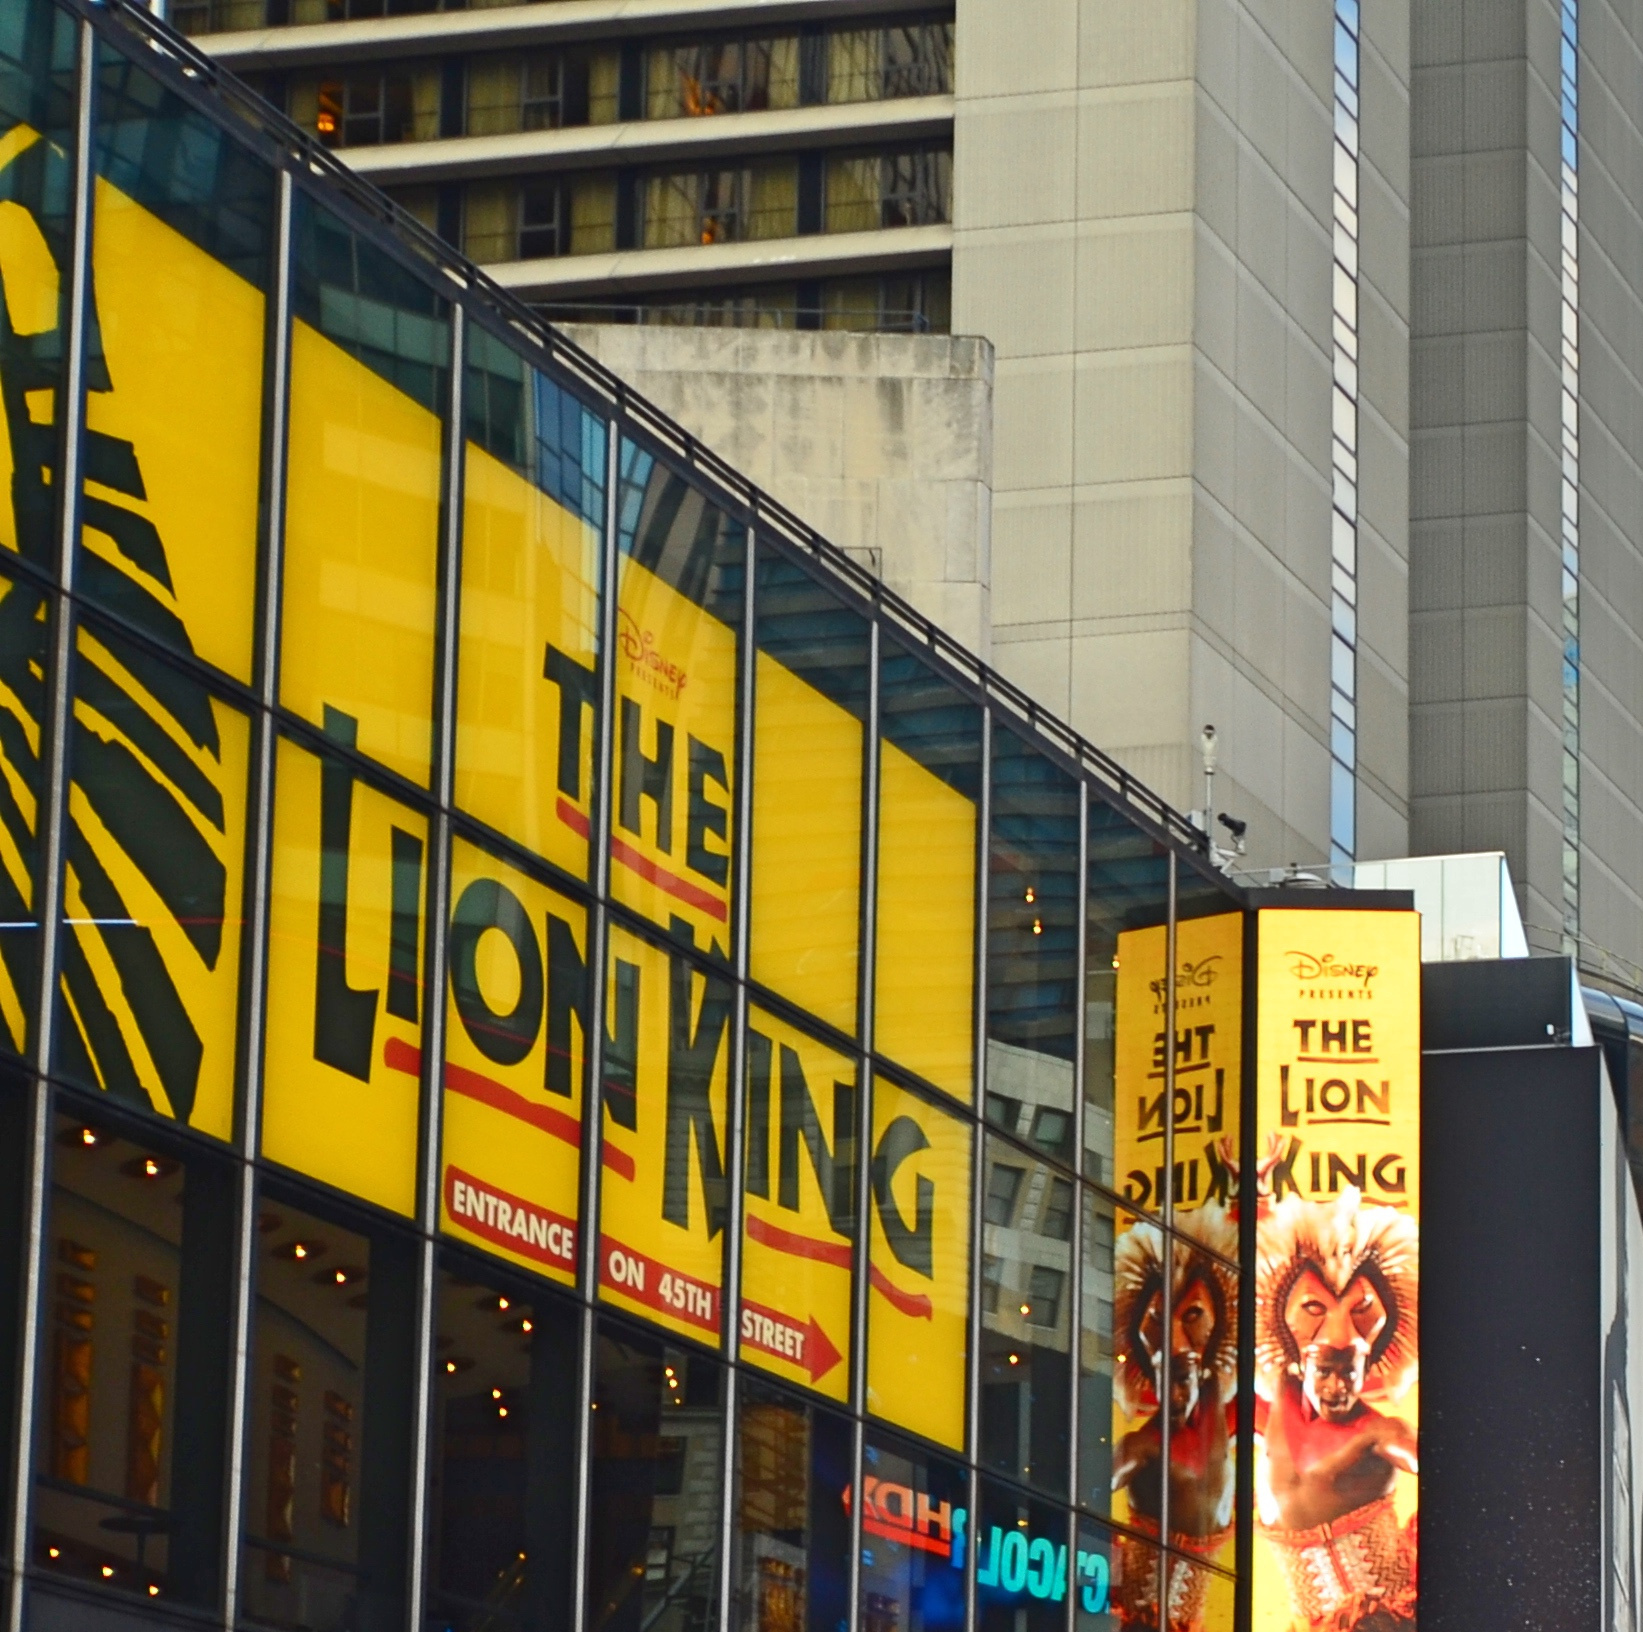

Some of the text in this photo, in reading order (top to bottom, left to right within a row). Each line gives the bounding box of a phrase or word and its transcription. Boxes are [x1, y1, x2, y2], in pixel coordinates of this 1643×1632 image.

[542, 641, 730, 888] THE
[314, 702, 637, 1132] LION
[1293, 1019, 1373, 1053] THE
[1299, 989, 1374, 1000] PRESENTS
[662, 911, 934, 1281] KING
[1280, 1065, 1391, 1127] LION
[1272, 1136, 1407, 1201] KING
[452, 1180, 804, 1361] ENTRANCE ON 45TH STREET
